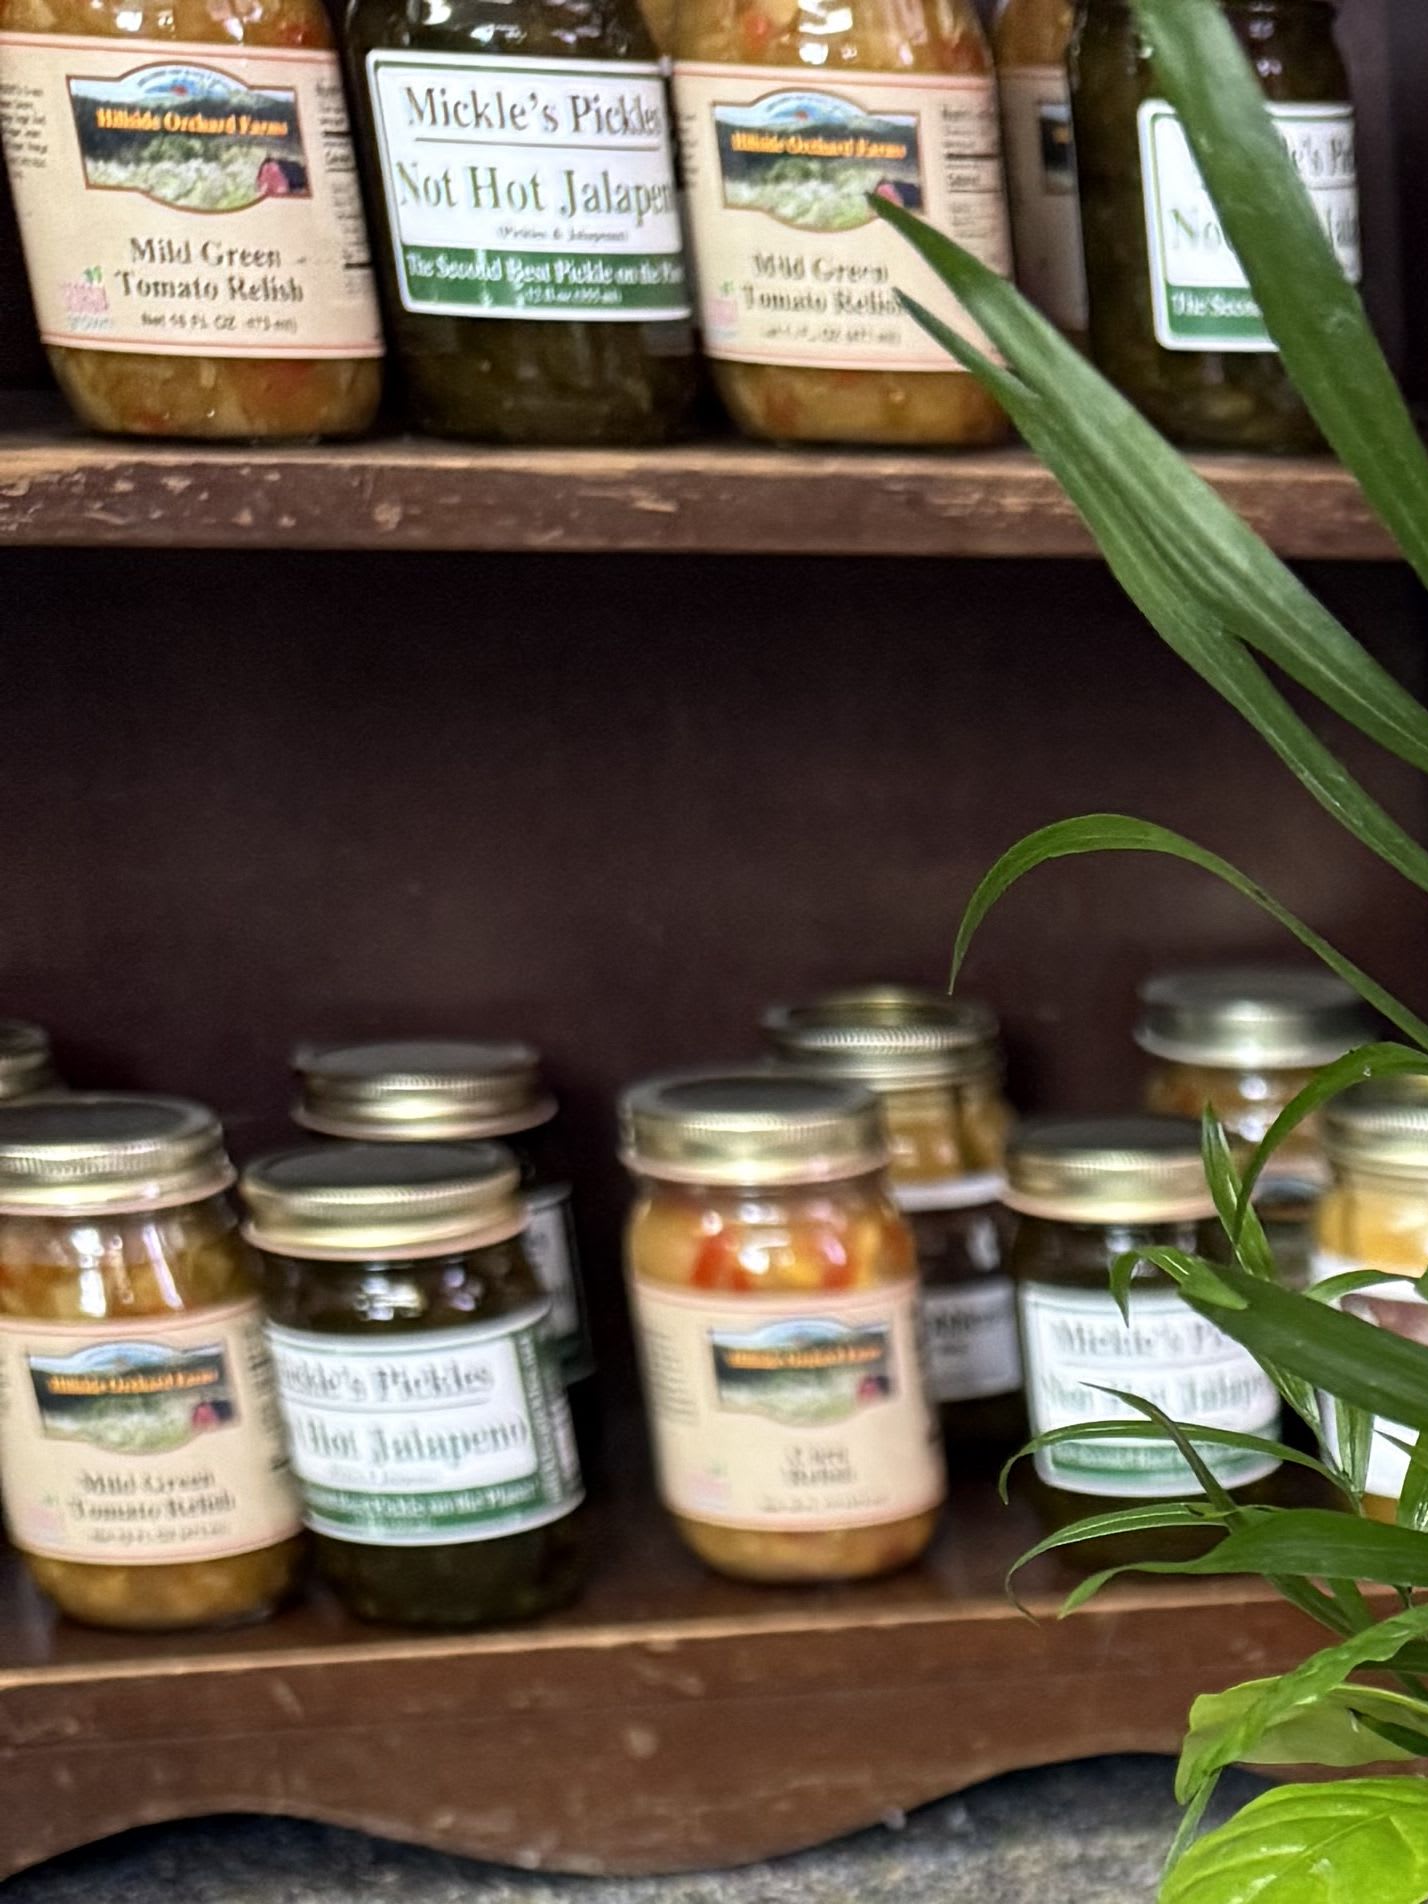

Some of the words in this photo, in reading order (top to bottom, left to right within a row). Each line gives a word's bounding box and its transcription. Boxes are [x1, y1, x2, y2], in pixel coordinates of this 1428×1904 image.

[406, 85, 559, 133] Mickle's
[163, 111, 237, 135] Orchard
[239, 115, 289, 138] Farms
[395, 160, 457, 208] Not
[467, 165, 545, 211] Hot
[130, 236, 192, 266] Mild
[201, 240, 282, 268] Green
[552, 259, 614, 285] Pickle
[752, 253, 806, 281] Mild
[810, 258, 889, 282] Green
[114, 269, 219, 299] Tomato
[227, 272, 304, 304] Relish
[742, 284, 828, 311] Tomato
